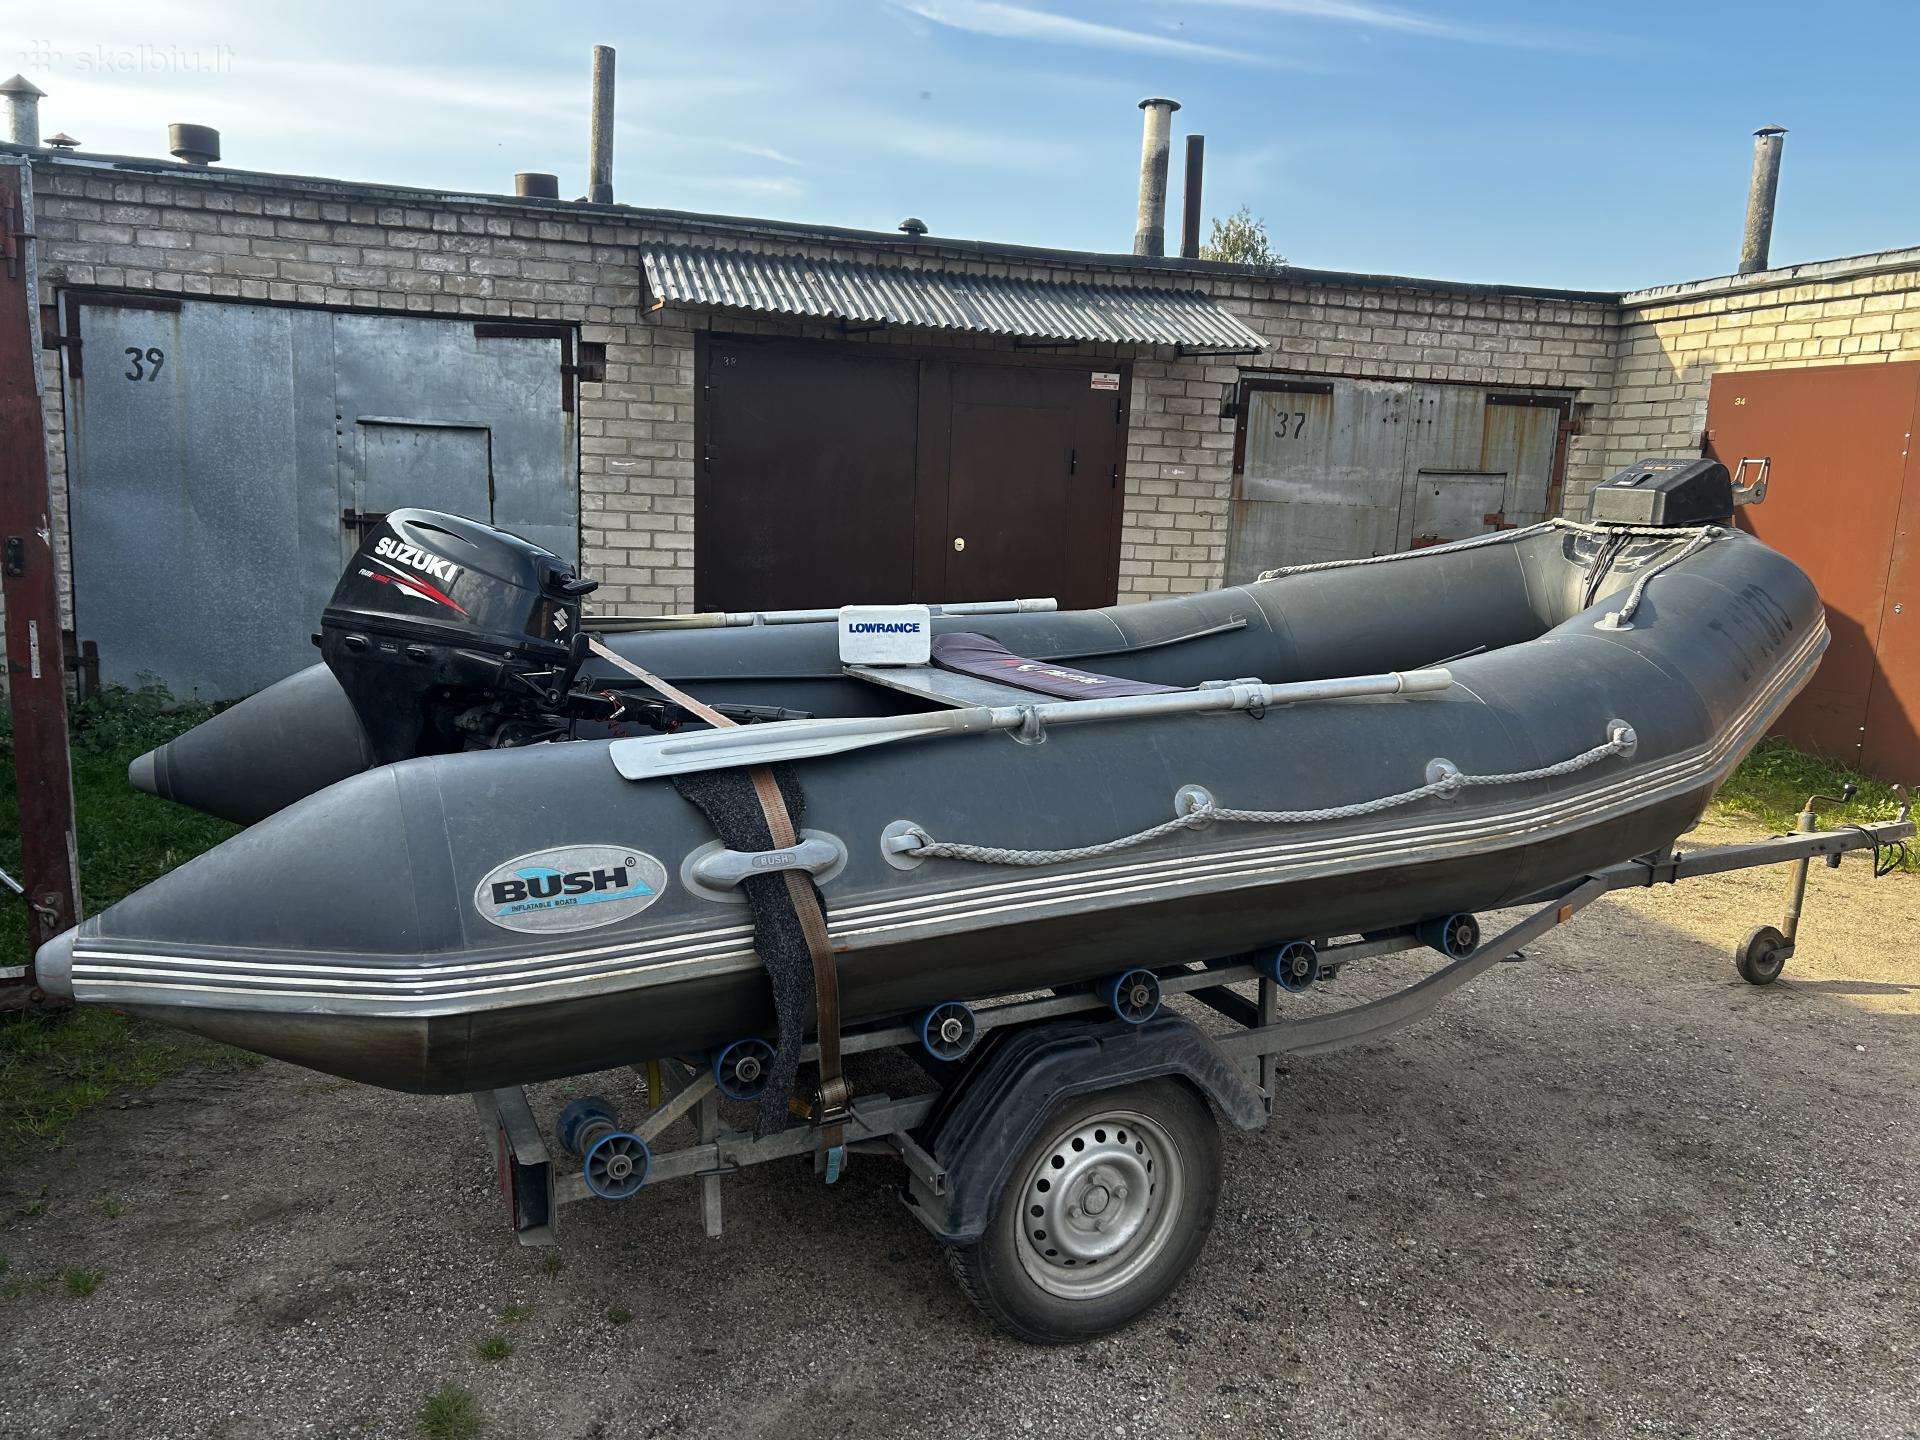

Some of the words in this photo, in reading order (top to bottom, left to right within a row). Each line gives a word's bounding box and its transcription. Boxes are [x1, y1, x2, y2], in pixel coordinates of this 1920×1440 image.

[125, 347, 165, 382] 39
[1734, 397, 1746, 406] 34
[1274, 411, 1306, 440] 37
[374, 537, 460, 583] SUZUKI
[848, 622, 921, 634] LOWRANCE
[760, 854, 789, 866] BUSH
[511, 902, 551, 912] INFLATABLE
[554, 897, 578, 907] BOATS
